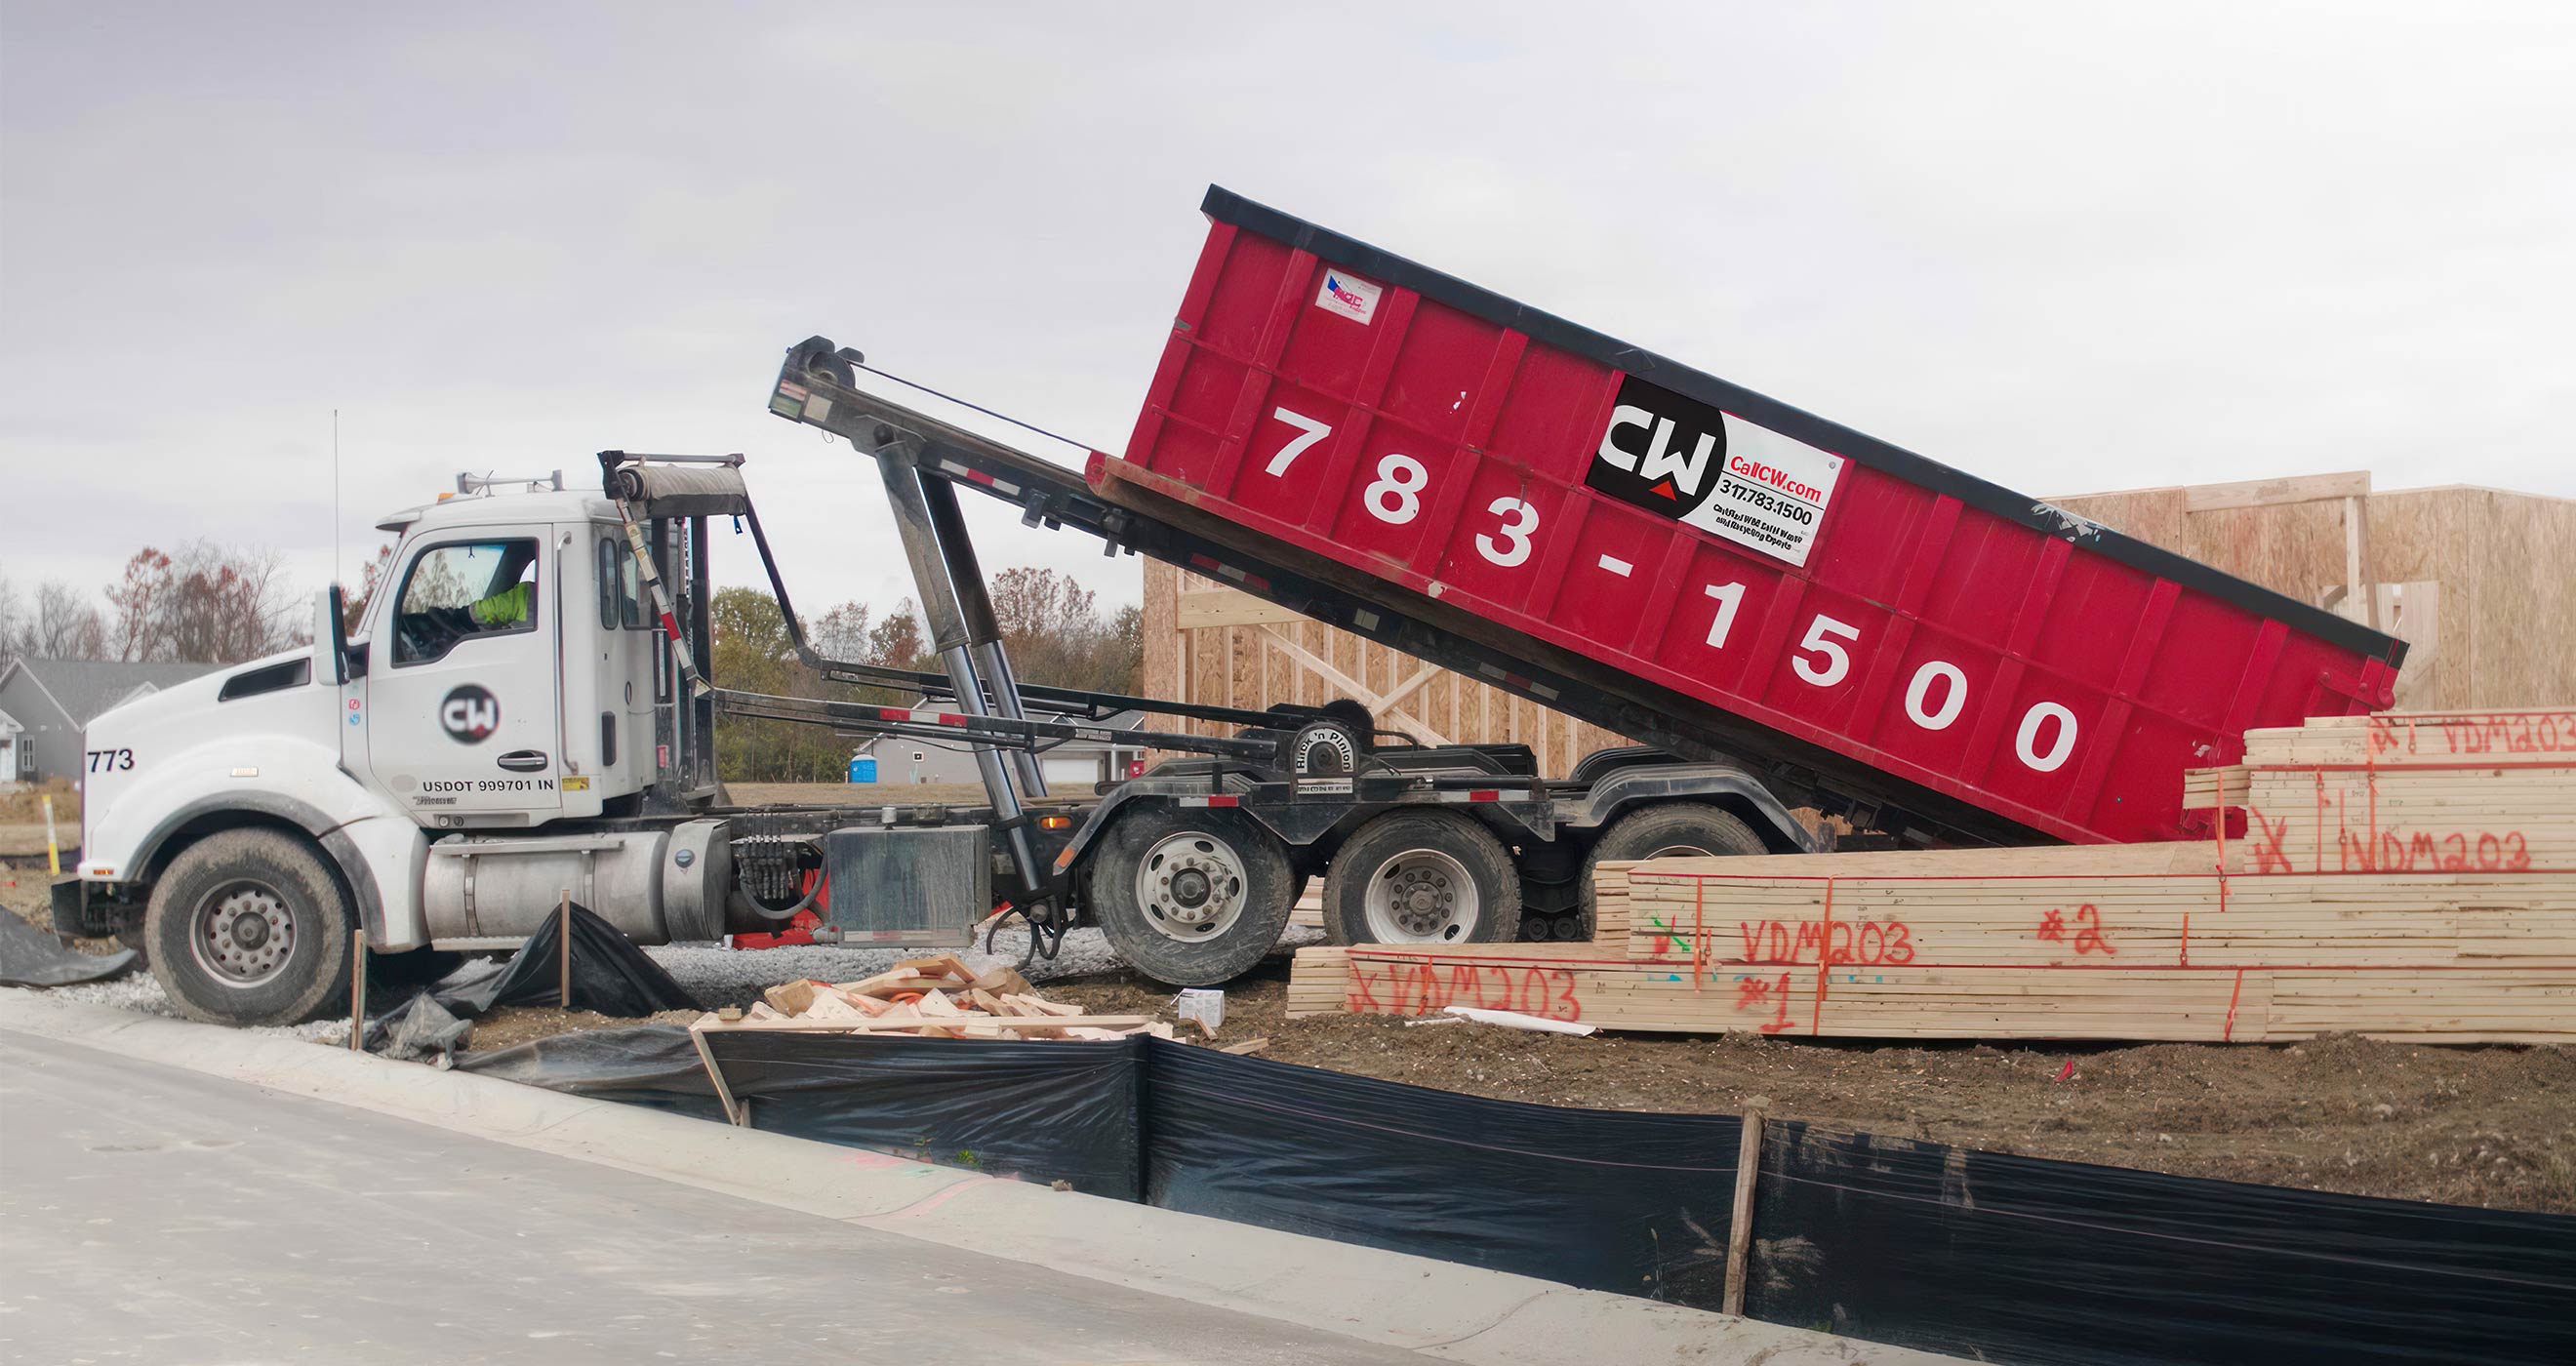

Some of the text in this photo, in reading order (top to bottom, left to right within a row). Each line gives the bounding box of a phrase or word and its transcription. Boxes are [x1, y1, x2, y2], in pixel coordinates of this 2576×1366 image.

[1597, 404, 1717, 497] CW
[1718, 479, 1813, 526] 317.783.1500
[1729, 455, 1822, 503] CallCW.com
[443, 697, 496, 732] CW
[87, 748, 136, 773] 773
[423, 781, 473, 792] USDOT
[478, 780, 532, 792] 999701
[538, 780, 554, 790] IN
[1740, 920, 1915, 965] VDM203
[2036, 903, 2117, 955] #2
[1389, 962, 1581, 1023] VDM203
